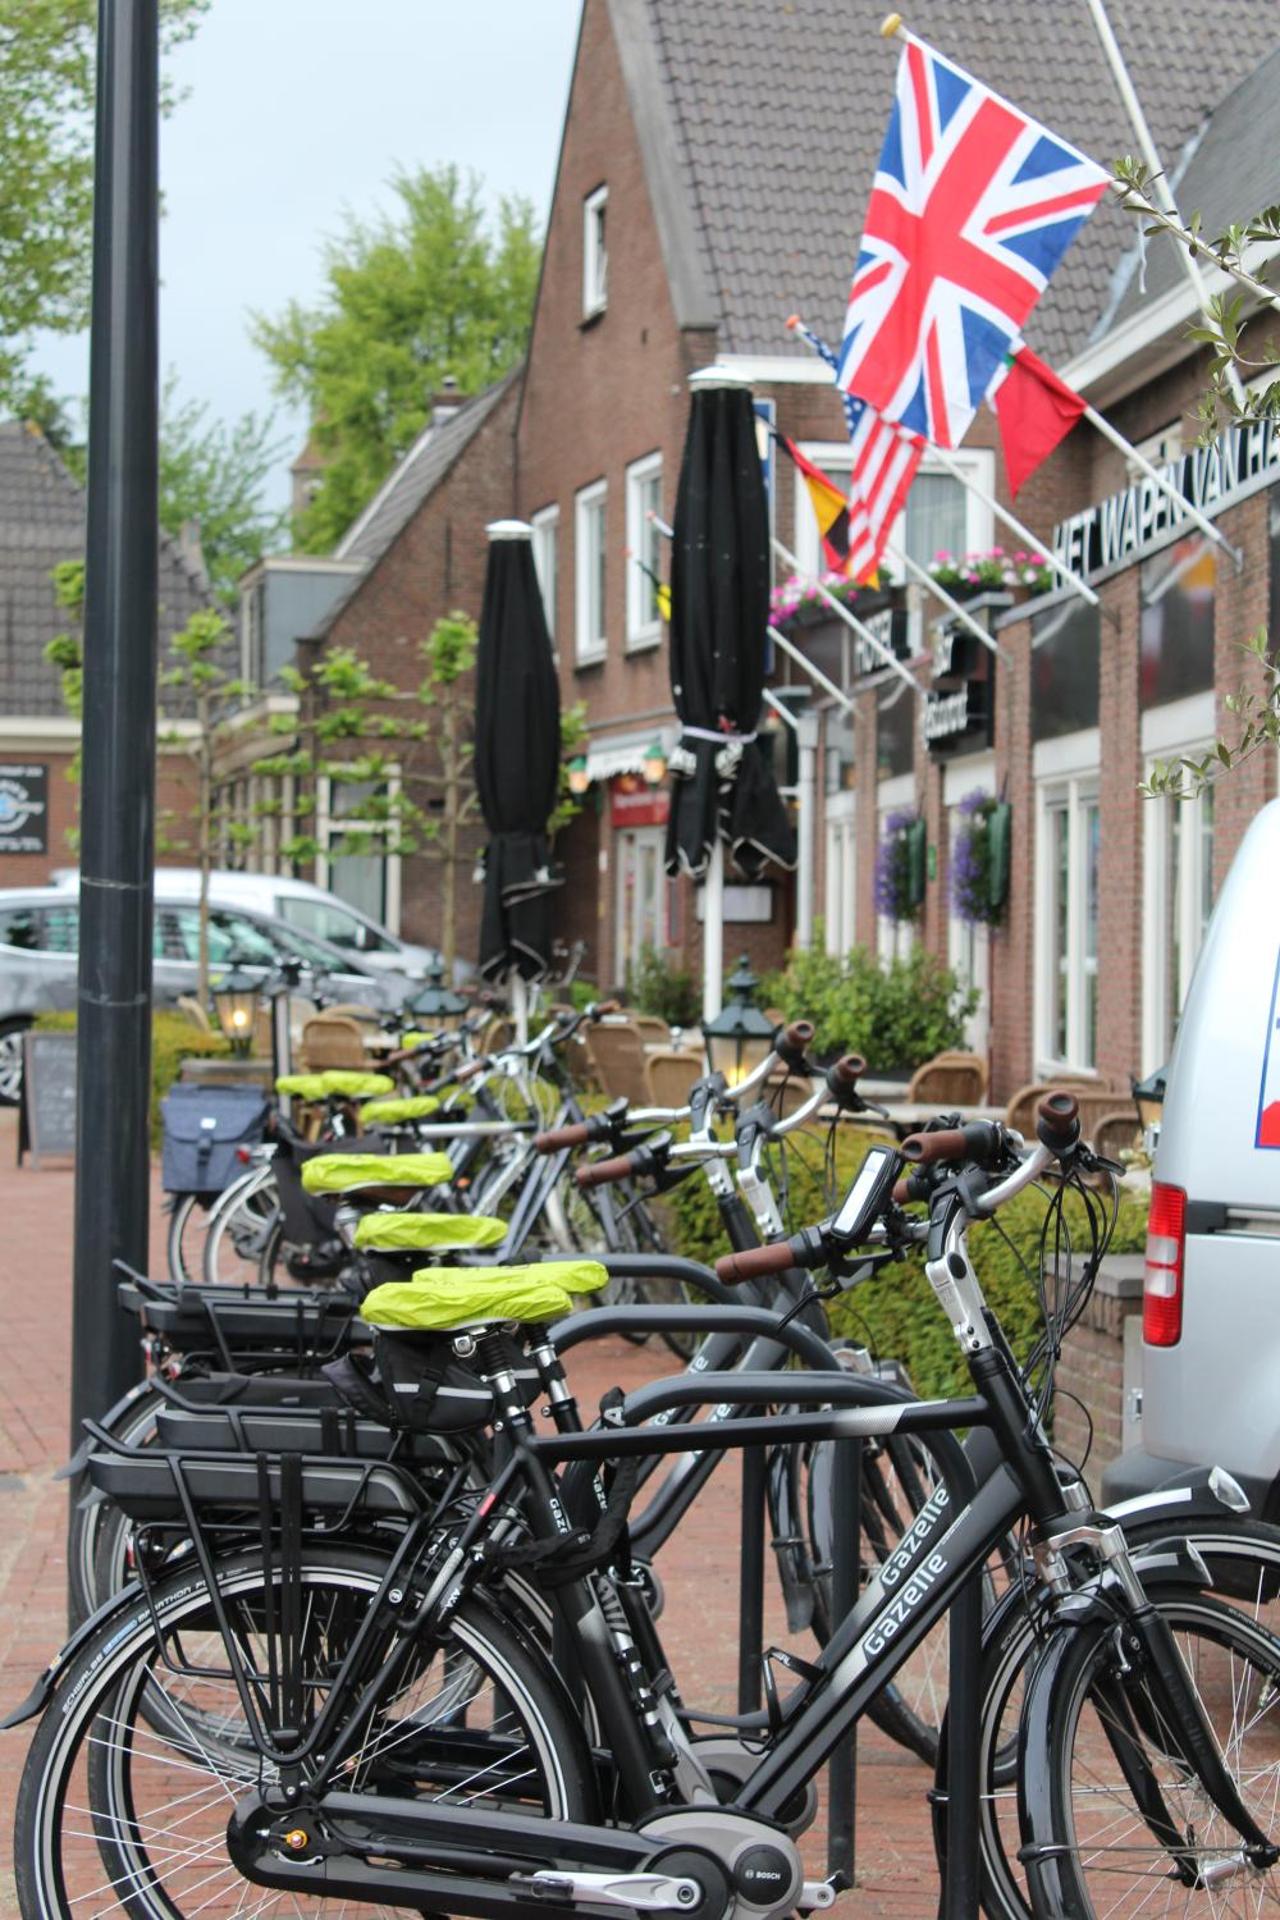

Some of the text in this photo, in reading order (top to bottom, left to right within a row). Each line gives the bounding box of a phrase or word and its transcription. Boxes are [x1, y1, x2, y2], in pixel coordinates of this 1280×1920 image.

[1053, 507, 1096, 592] HET
[1101, 455, 1187, 566] WAPEN
[1192, 423, 1240, 512] VAN
[550, 1498, 569, 1535] Gaze
[881, 1487, 950, 1586] Gazelle
[137, 1585, 192, 1623] MATHON
[864, 1553, 948, 1655] Gazelle
[756, 1871, 781, 1880] BOSCH
